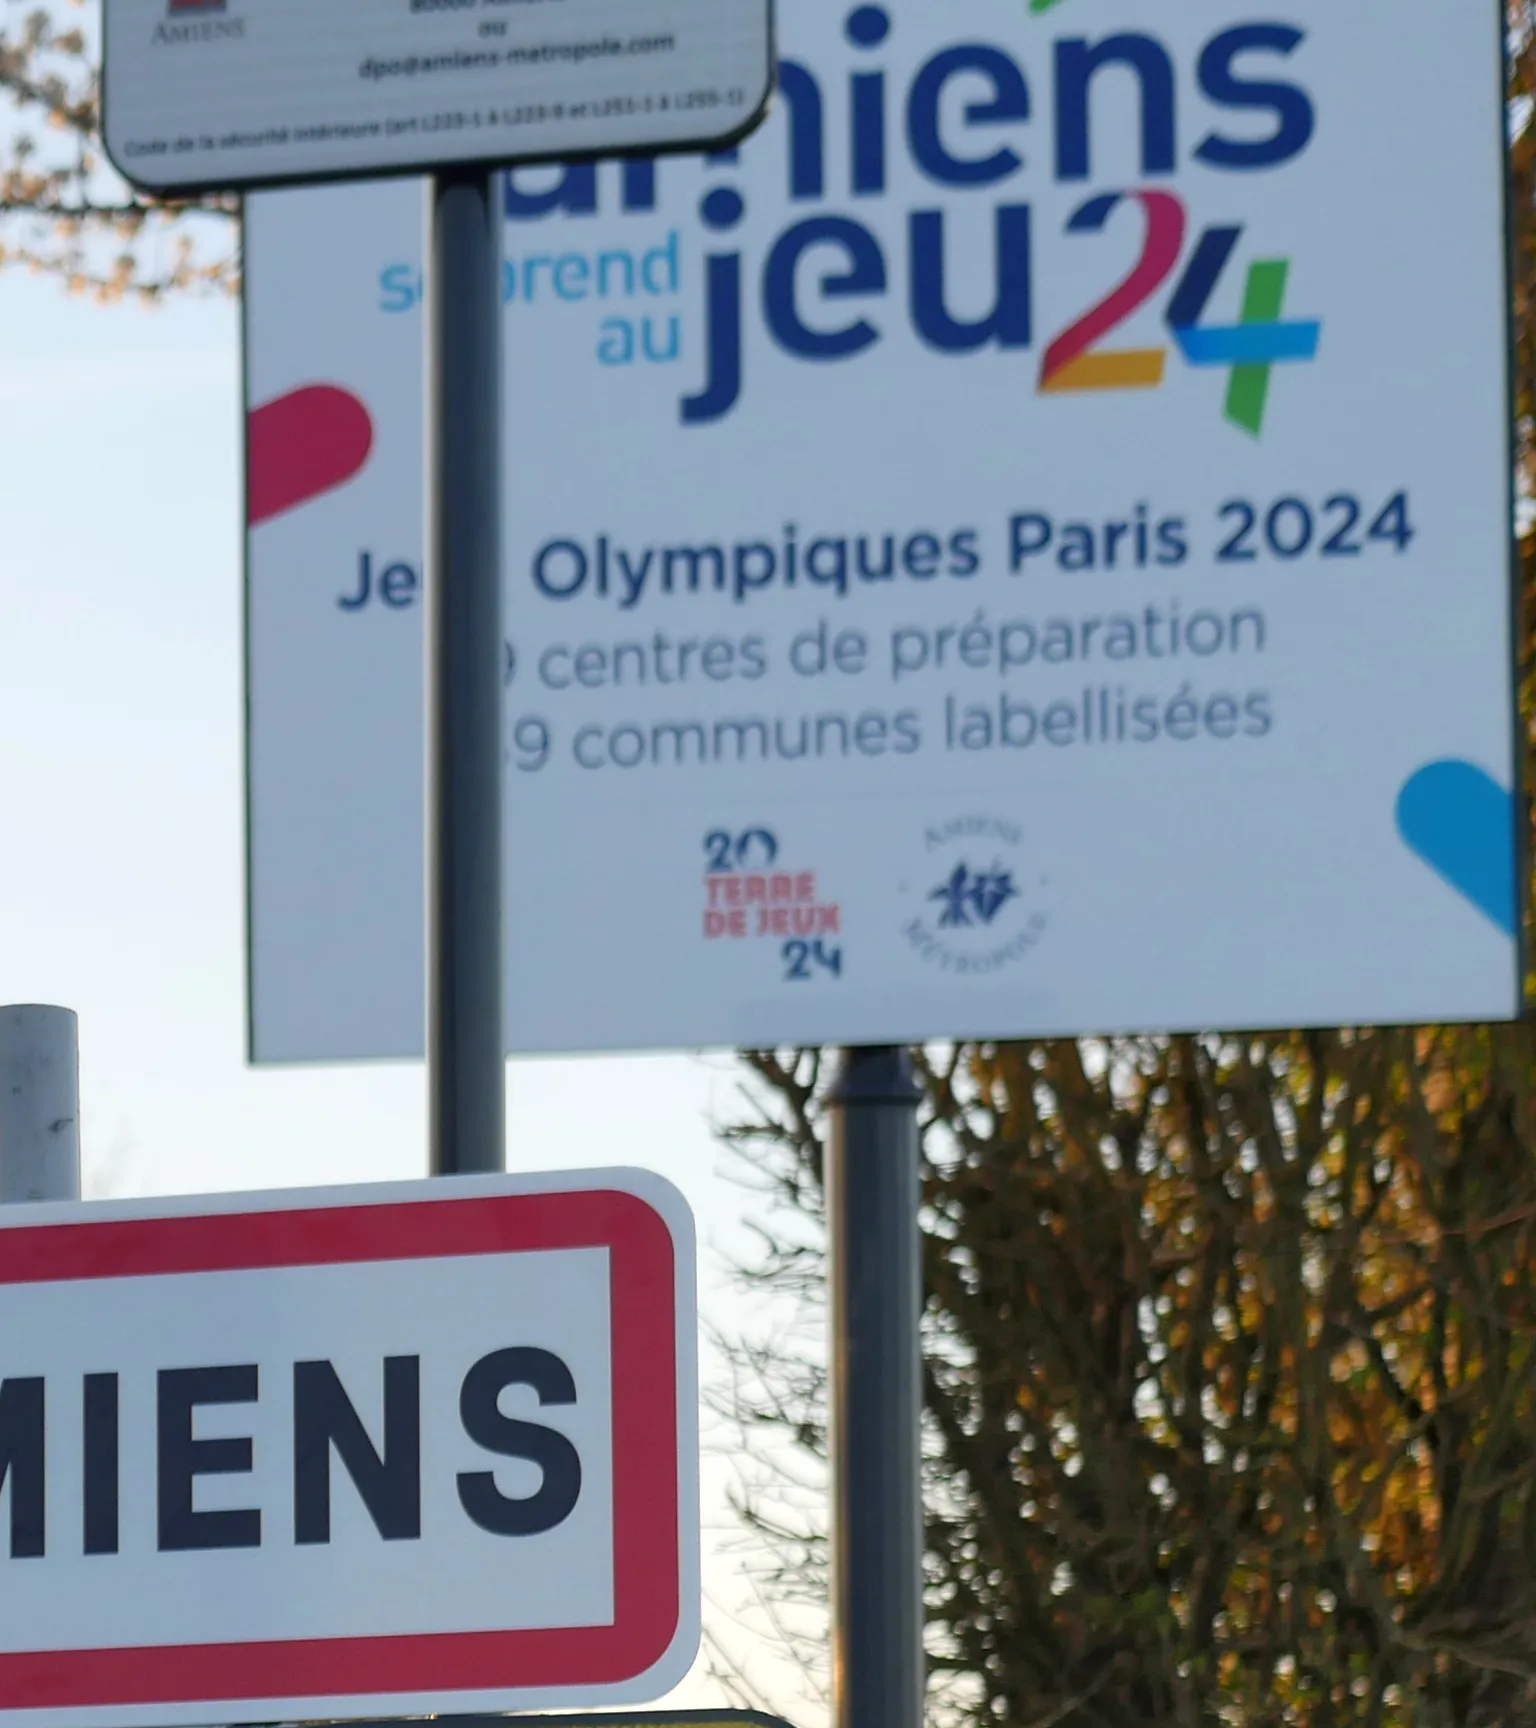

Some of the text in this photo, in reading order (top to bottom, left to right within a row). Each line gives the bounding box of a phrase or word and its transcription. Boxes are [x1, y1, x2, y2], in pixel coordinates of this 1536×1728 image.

[478, 20, 507, 37] ou
[596, 314, 680, 366] au
[531, 522, 980, 609] Olympiques
[1007, 502, 1189, 574] Paris
[1215, 489, 1416, 563] 2024
[537, 631, 767, 690] centres
[788, 619, 868, 677] de
[891, 602, 1266, 684] préparation
[572, 709, 921, 770] communes
[944, 680, 1273, 751] labellisées
[705, 872, 815, 905] TERRE
[704, 904, 841, 938] DE JEUX
[783, 939, 842, 980] 24
